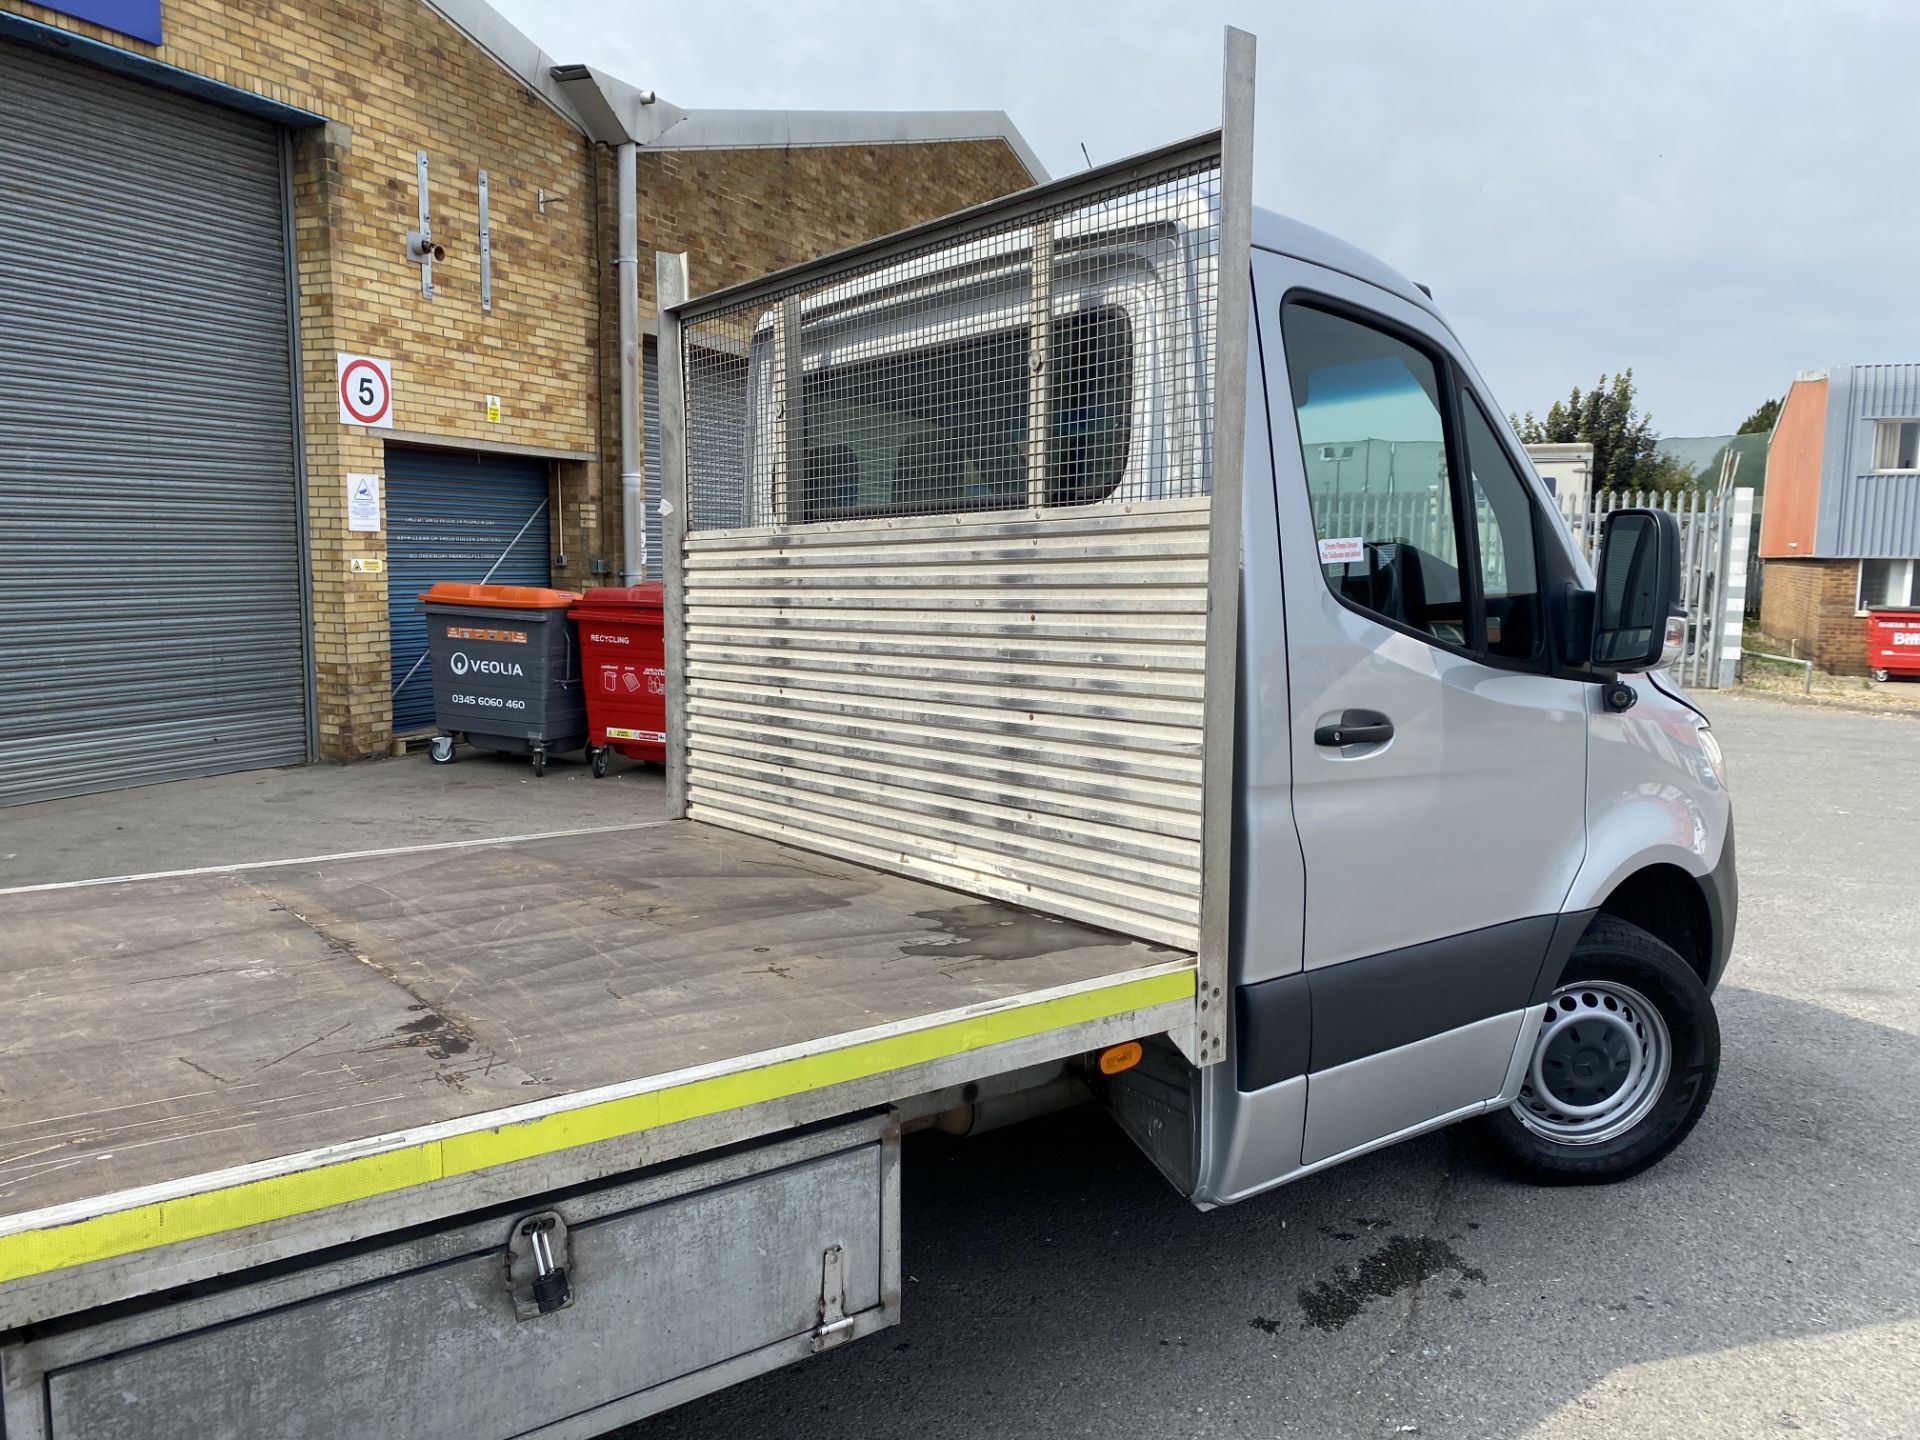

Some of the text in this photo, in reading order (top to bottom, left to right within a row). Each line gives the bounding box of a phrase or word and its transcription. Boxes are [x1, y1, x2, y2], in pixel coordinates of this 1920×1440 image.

[358, 377, 374, 406] 5
[590, 634, 630, 645] RECYCLING
[470, 659, 524, 677] VEOLIA
[451, 694, 526, 710] 0345 6060 460
